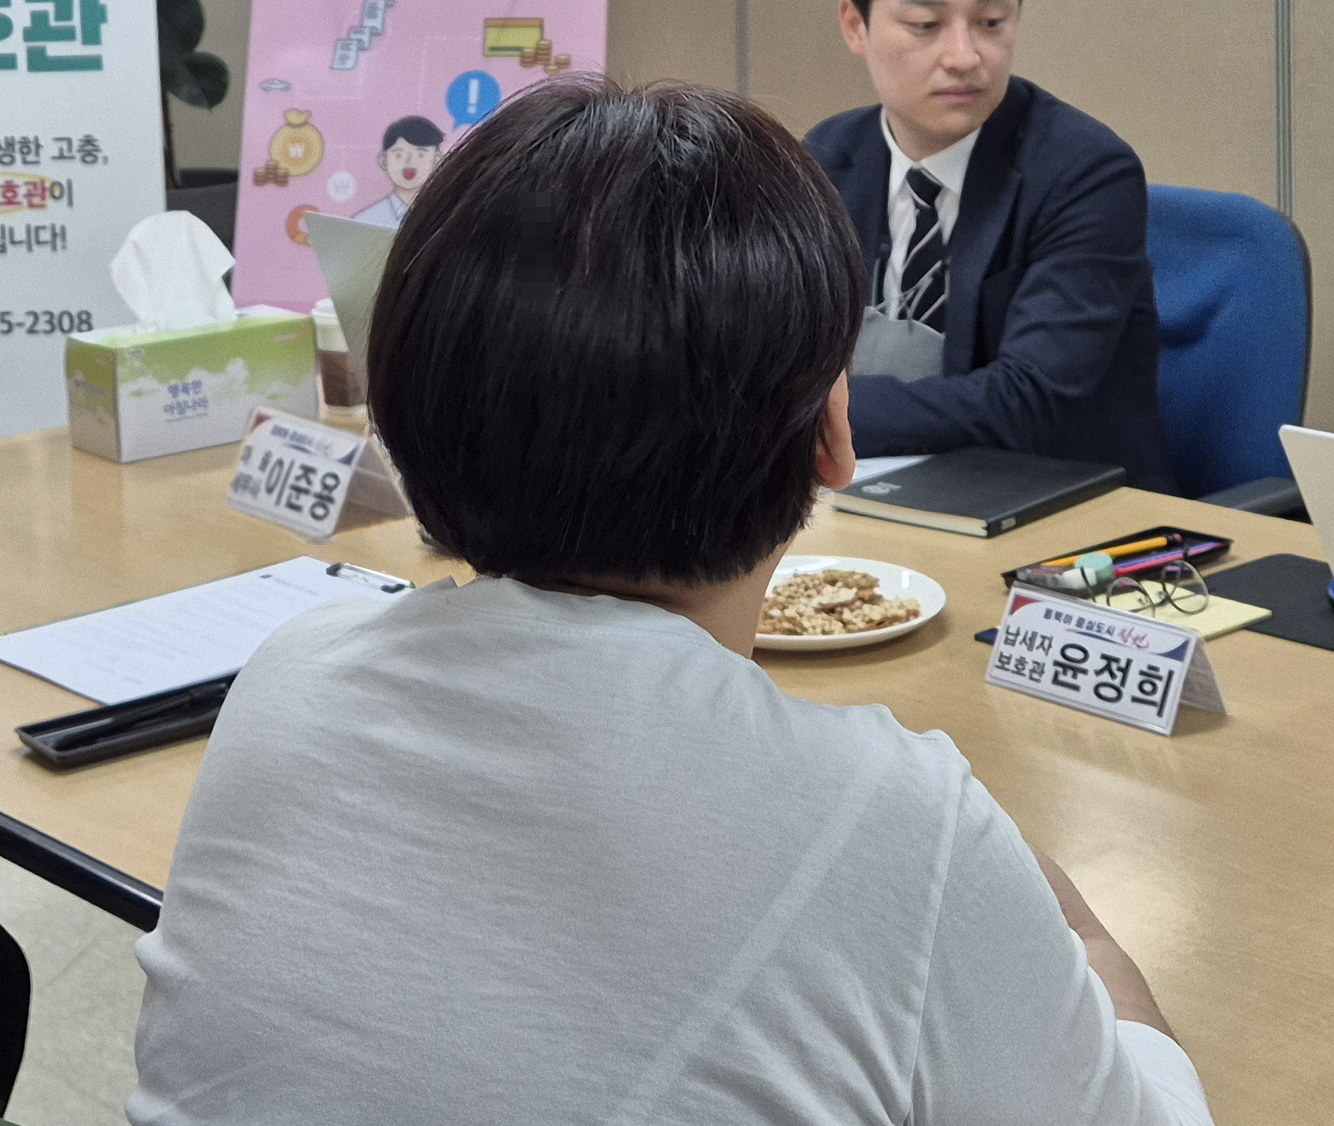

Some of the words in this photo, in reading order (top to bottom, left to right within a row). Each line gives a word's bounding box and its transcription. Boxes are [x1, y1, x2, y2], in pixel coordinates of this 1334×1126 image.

[50, 134, 109, 166] 고충,
[264, 457, 341, 522] 이준용
[1002, 625, 1054, 657] 납세자
[1075, 616, 1117, 637] 중심도시
[994, 650, 1047, 684] 보호관
[1051, 642, 1175, 718] 윤정희
